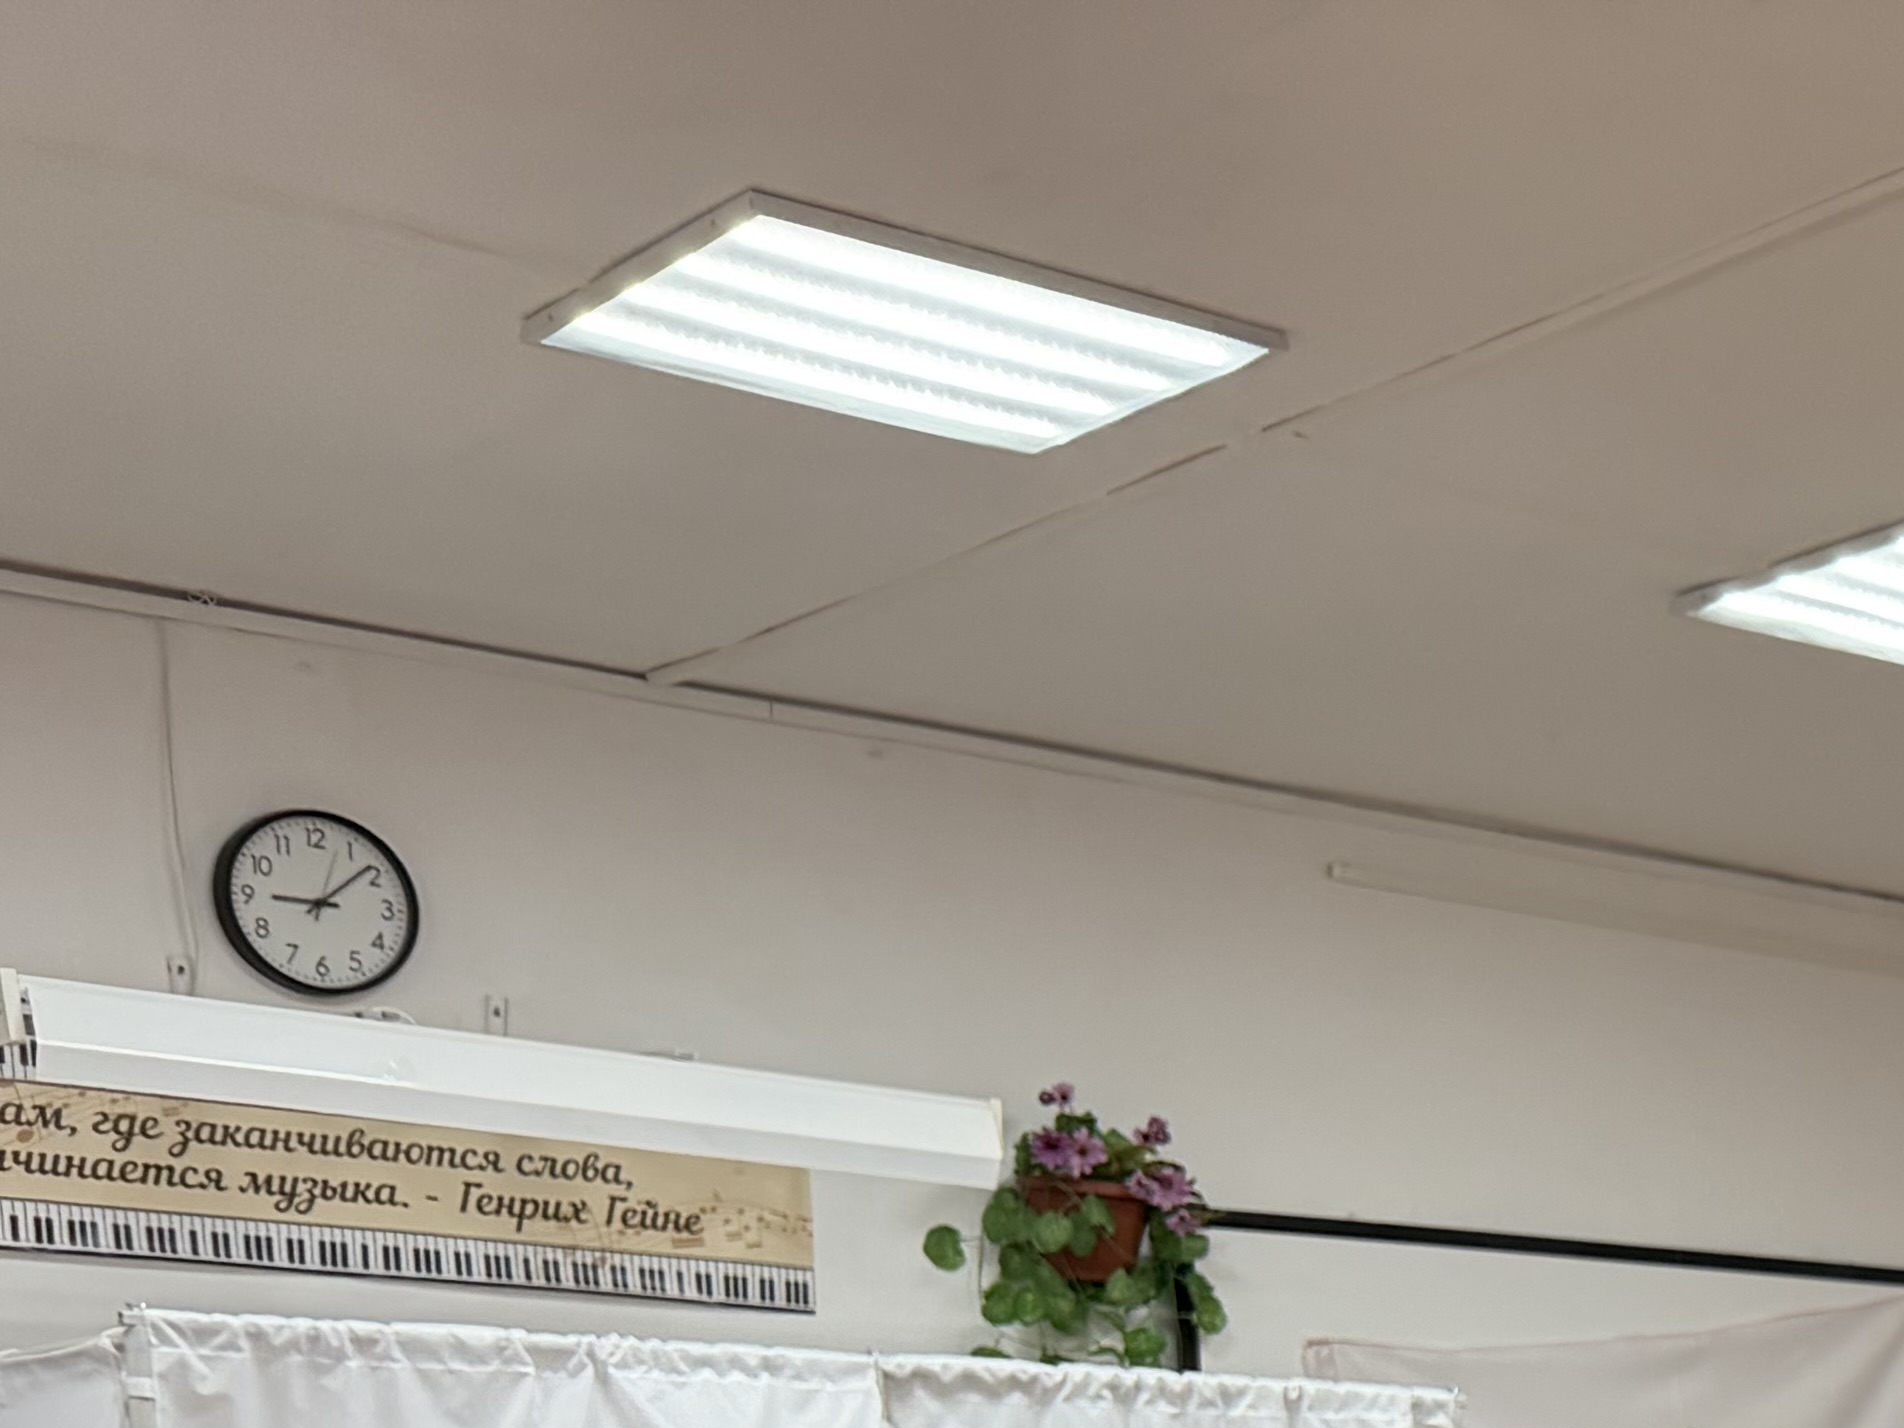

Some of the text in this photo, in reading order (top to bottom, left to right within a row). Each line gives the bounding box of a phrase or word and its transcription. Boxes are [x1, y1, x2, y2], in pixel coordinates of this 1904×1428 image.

[274, 833, 290, 856] 11
[306, 827, 326, 849] 12
[347, 841, 353, 861] 1
[251, 854, 273, 877] 10
[368, 865, 382, 888] 2
[241, 883, 255, 904] 9
[381, 898, 395, 921] 3
[255, 917, 270, 939] 8
[371, 931, 385, 951] 4
[286, 942, 299, 965] 7
[349, 951, 362, 972] 5
[315, 956, 330, 977] 6
[0, 1102, 634, 1191] ам, где заканчиваются слова,
[0, 1149, 228, 1192] ачинается
[238, 1170, 410, 1214] музыка.
[459, 1180, 589, 1233] Генрих
[605, 1194, 704, 1236] Гейне
